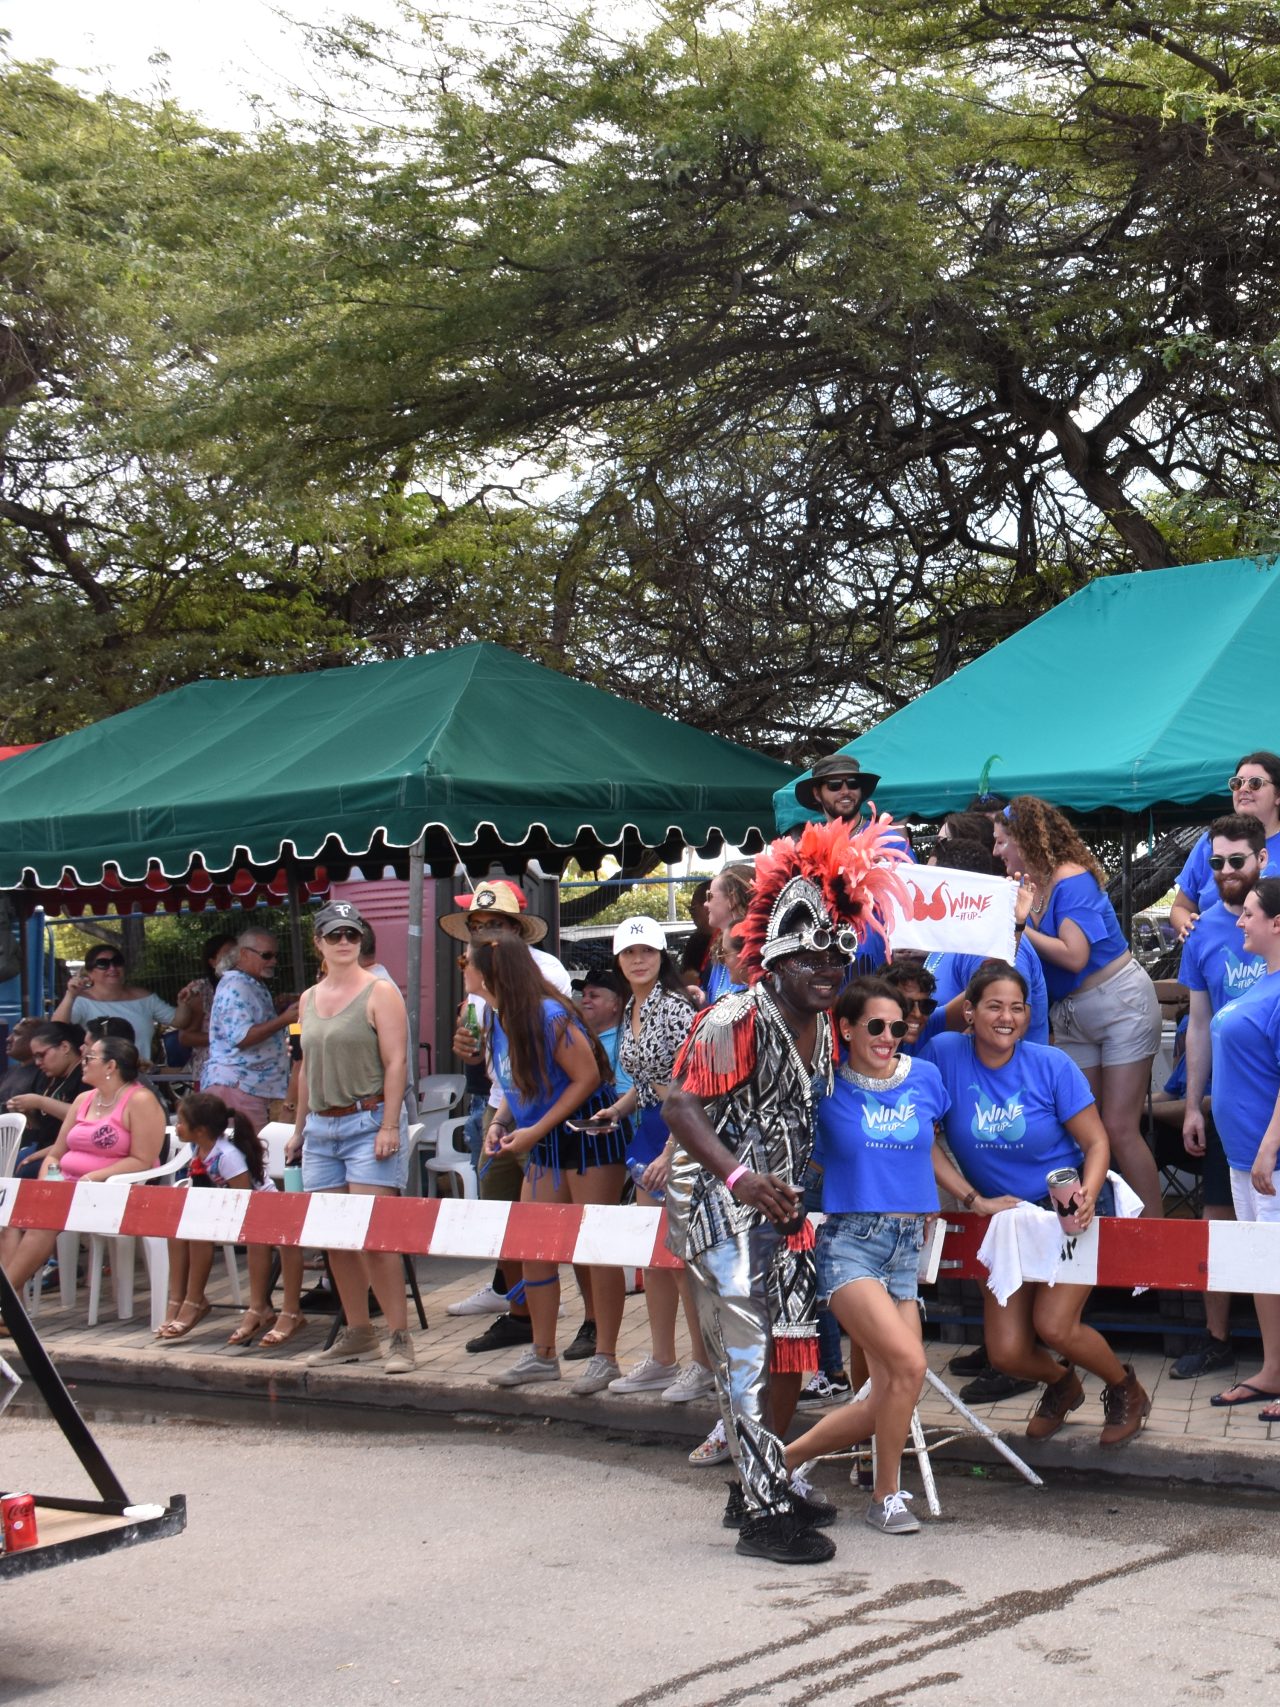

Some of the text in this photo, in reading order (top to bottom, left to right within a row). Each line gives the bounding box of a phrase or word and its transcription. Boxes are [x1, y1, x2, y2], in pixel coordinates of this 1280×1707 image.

[945, 889, 993, 917] WINE
[630, 923, 644, 934] NY
[1225, 960, 1268, 987] WINE
[862, 1103, 916, 1129] WINE
[975, 1102, 1024, 1130] WINE
